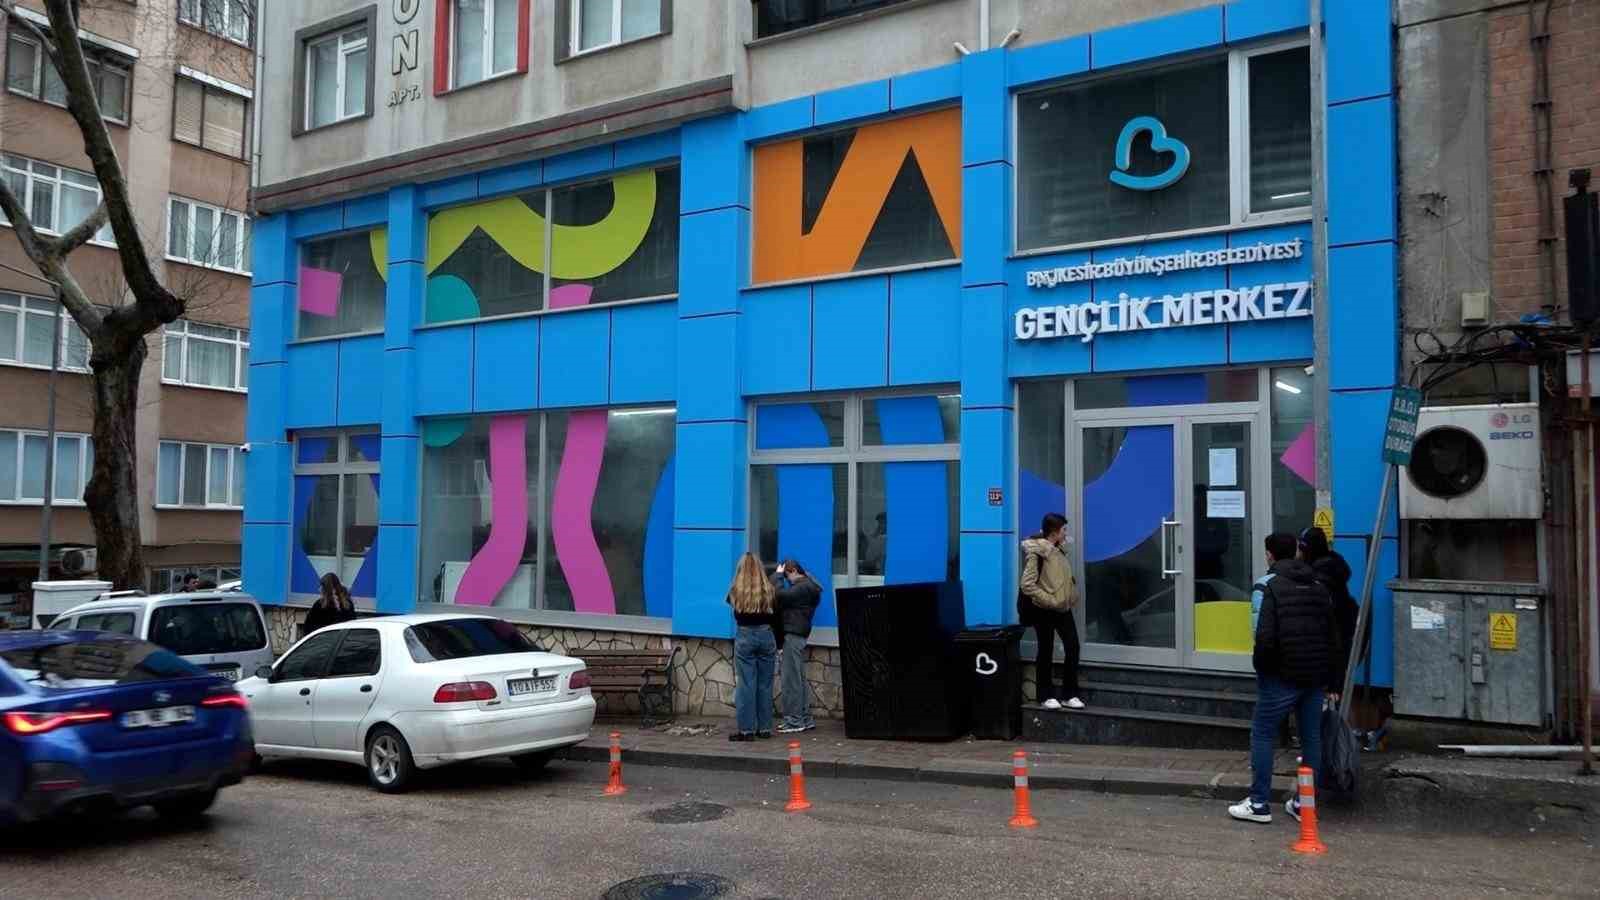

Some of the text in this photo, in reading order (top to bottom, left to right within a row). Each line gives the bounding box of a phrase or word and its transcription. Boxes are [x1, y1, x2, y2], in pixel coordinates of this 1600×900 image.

[388, 85, 421, 107] APT.
[1205, 237, 1303, 267] BELEDİYESİ
[1014, 281, 1314, 343] GENÇLİK MERKEZ
[1512, 414, 1531, 424] LG
[1489, 431, 1534, 440] BEKO
